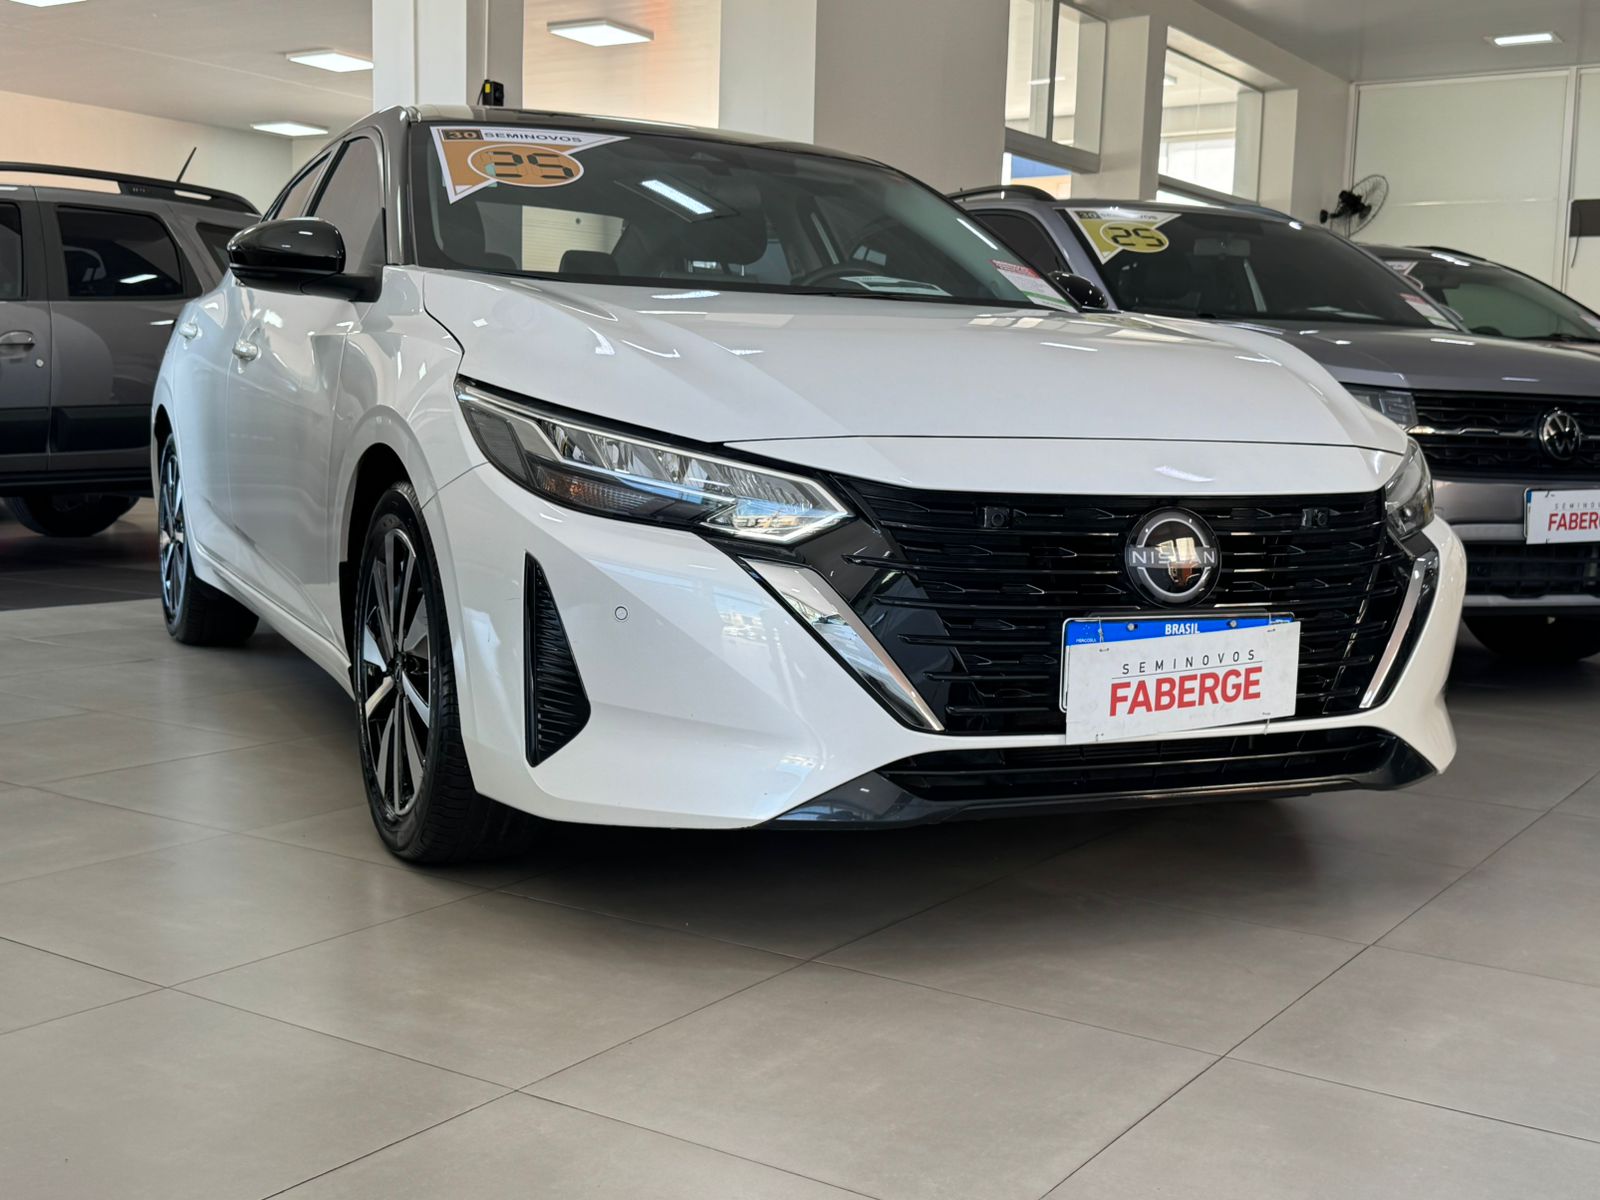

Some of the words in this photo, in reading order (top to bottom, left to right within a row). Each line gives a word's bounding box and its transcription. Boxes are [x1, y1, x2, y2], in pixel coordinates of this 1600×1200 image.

[448, 131, 477, 140] 30
[484, 131, 582, 143] SEMINOVOS
[485, 151, 574, 179] 25
[1108, 227, 1164, 247] 25
[1547, 511, 1600, 532] FABER
[1164, 623, 1201, 636] BRASIL
[1122, 649, 1255, 675] SEMINOVOS
[1109, 666, 1263, 717] FABERGE
